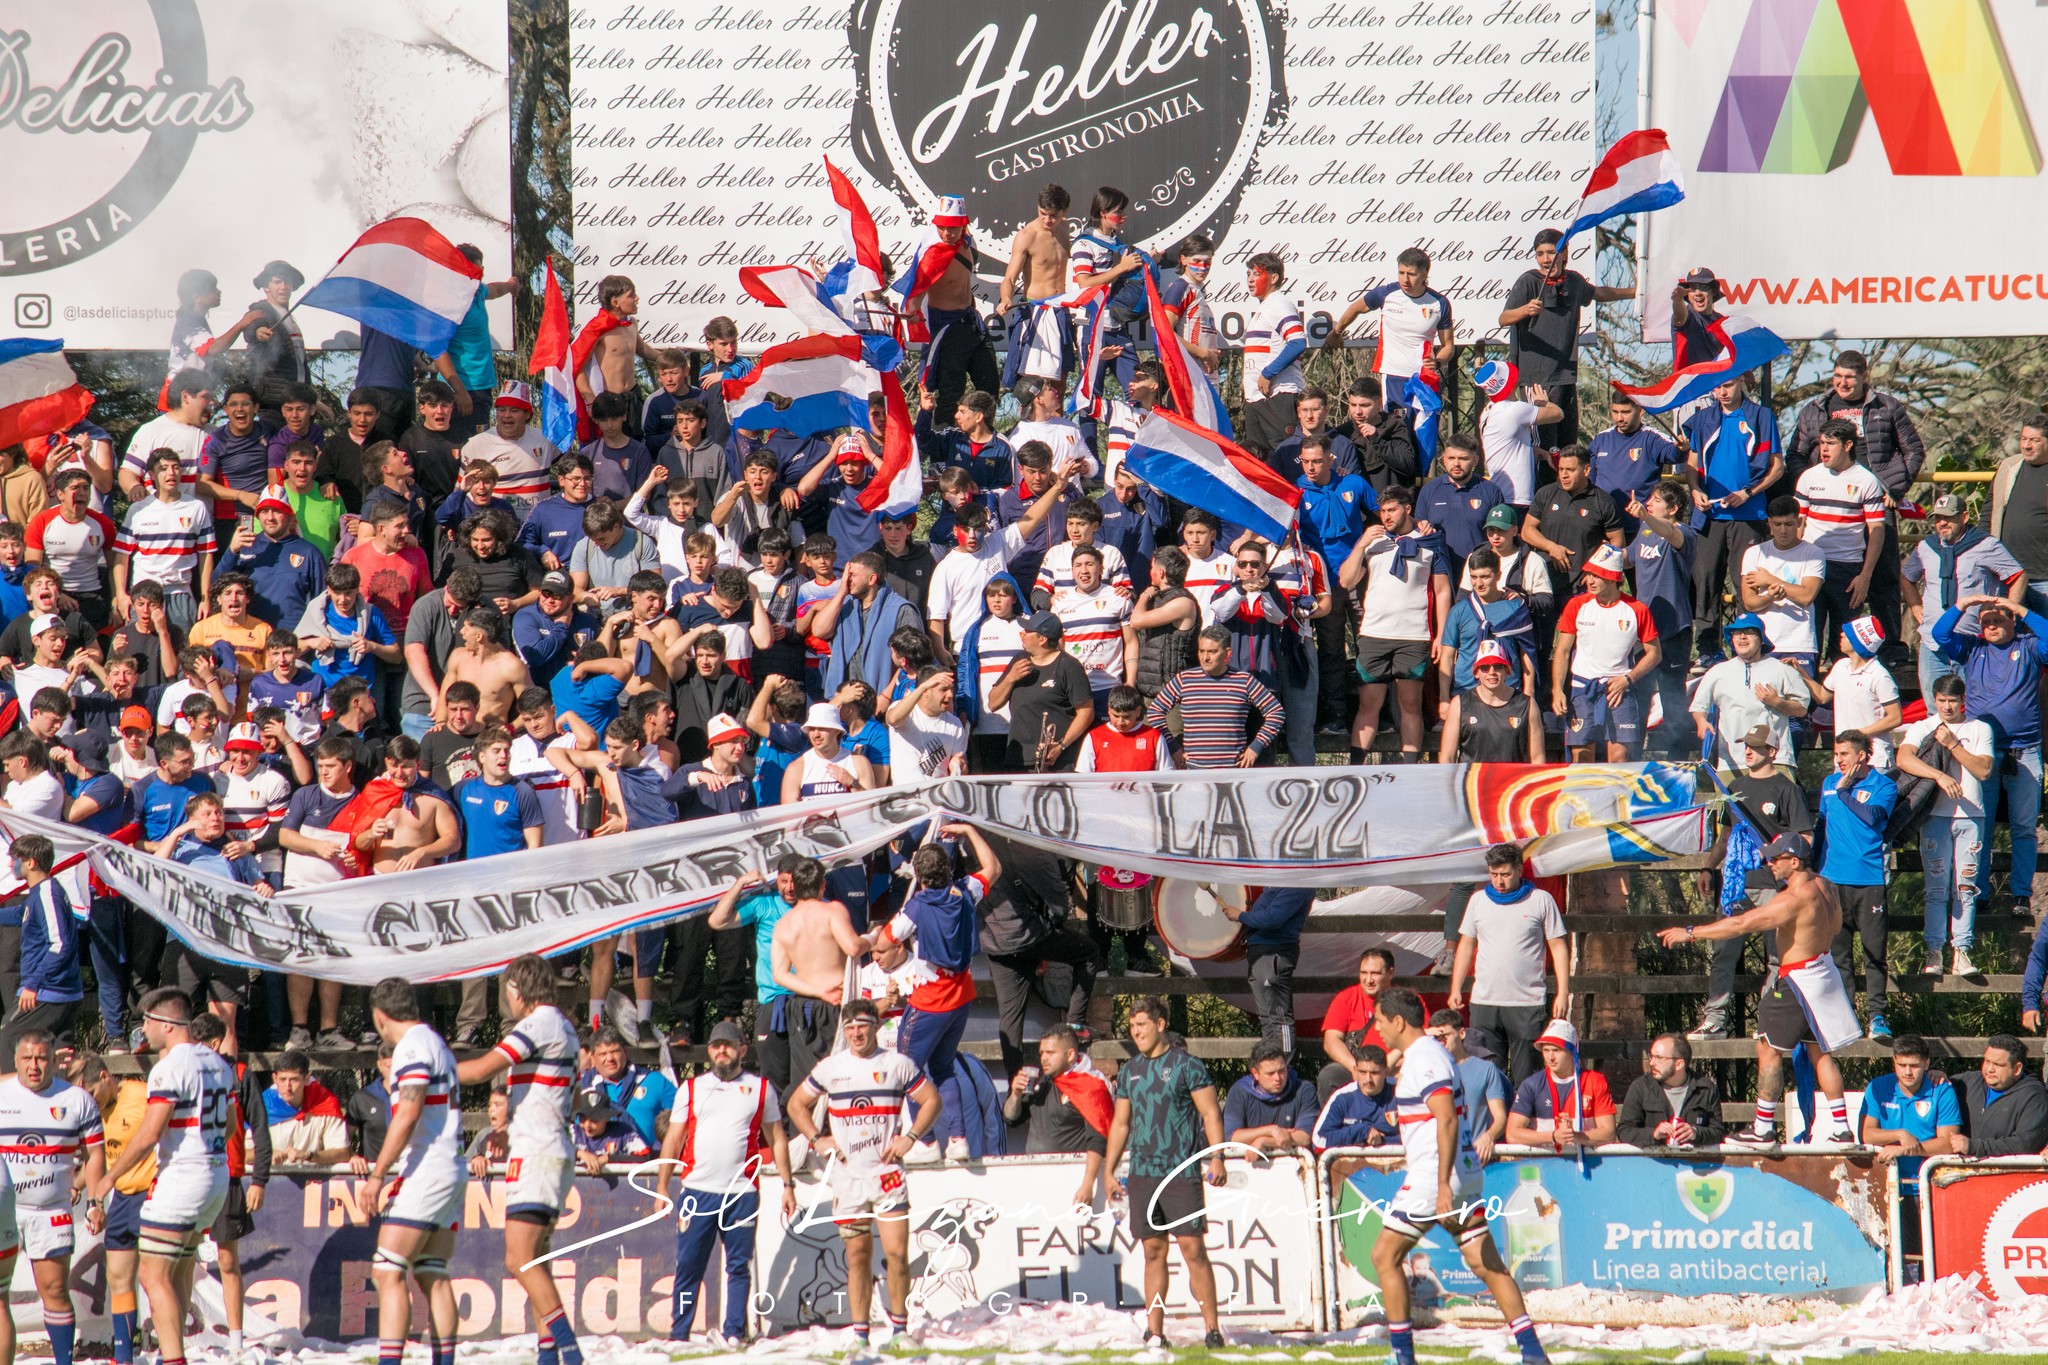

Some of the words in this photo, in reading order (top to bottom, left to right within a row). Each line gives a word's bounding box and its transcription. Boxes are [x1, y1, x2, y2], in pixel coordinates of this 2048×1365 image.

[606, 4, 685, 31] Heller
[694, 4, 773, 32] Heller
[1307, 2, 1386, 30] Heller
[1395, 1, 1473, 28] Heller
[1482, 0, 1561, 27] Heller
[644, 44, 724, 71] Heller
[732, 44, 811, 71] Heller
[1345, 41, 1423, 68] Heller
[1432, 39, 1511, 67] Heller
[912, 0, 1217, 164] Heller
[1307, 80, 1386, 108] Heller
[1395, 79, 1473, 107] Heller
[1482, 78, 1561, 106] Heller
[607, 83, 686, 110] Heller
[695, 83, 774, 111] Heller
[645, 122, 724, 150] Heller
[733, 122, 812, 150] Heller
[987, 92, 1204, 182] GASTRONOMIA
[1345, 119, 1424, 147] Heller
[1432, 118, 1511, 146] Heller
[608, 162, 687, 189] Heller
[696, 162, 775, 189] Heller
[1308, 159, 1386, 187] Heller
[1395, 158, 1474, 186] Heller
[1482, 156, 1561, 184] Heller
[646, 201, 725, 228] Heller
[734, 201, 813, 228] Heller
[1259, 198, 1337, 226] Heller
[1346, 197, 1424, 225] Heller
[1433, 197, 1512, 224] Heller
[609, 240, 688, 268] Heller
[697, 240, 776, 267] Heller
[1309, 237, 1387, 265] Heller
[648, 280, 727, 305] Heller
[1678, 273, 2048, 305] WW.AMERICATUC
[1488, 378, 1497, 388] LOS
[1855, 622, 1873, 647] BLANCOS
[1865, 624, 1875, 636] LOS
[201, 1087, 228, 1134] 20
[843, 1114, 887, 1127] Macro
[2, 1150, 60, 1164] Macro
[13, 1172, 55, 1195] mperial
[1017, 1218, 1277, 1256] FARMCIA
[1603, 1221, 1814, 1251] Primordial
[1441, 1269, 1479, 1281] Primo
[1592, 1259, 1660, 1281] Línea
[1669, 1258, 1827, 1281] antibacterial
